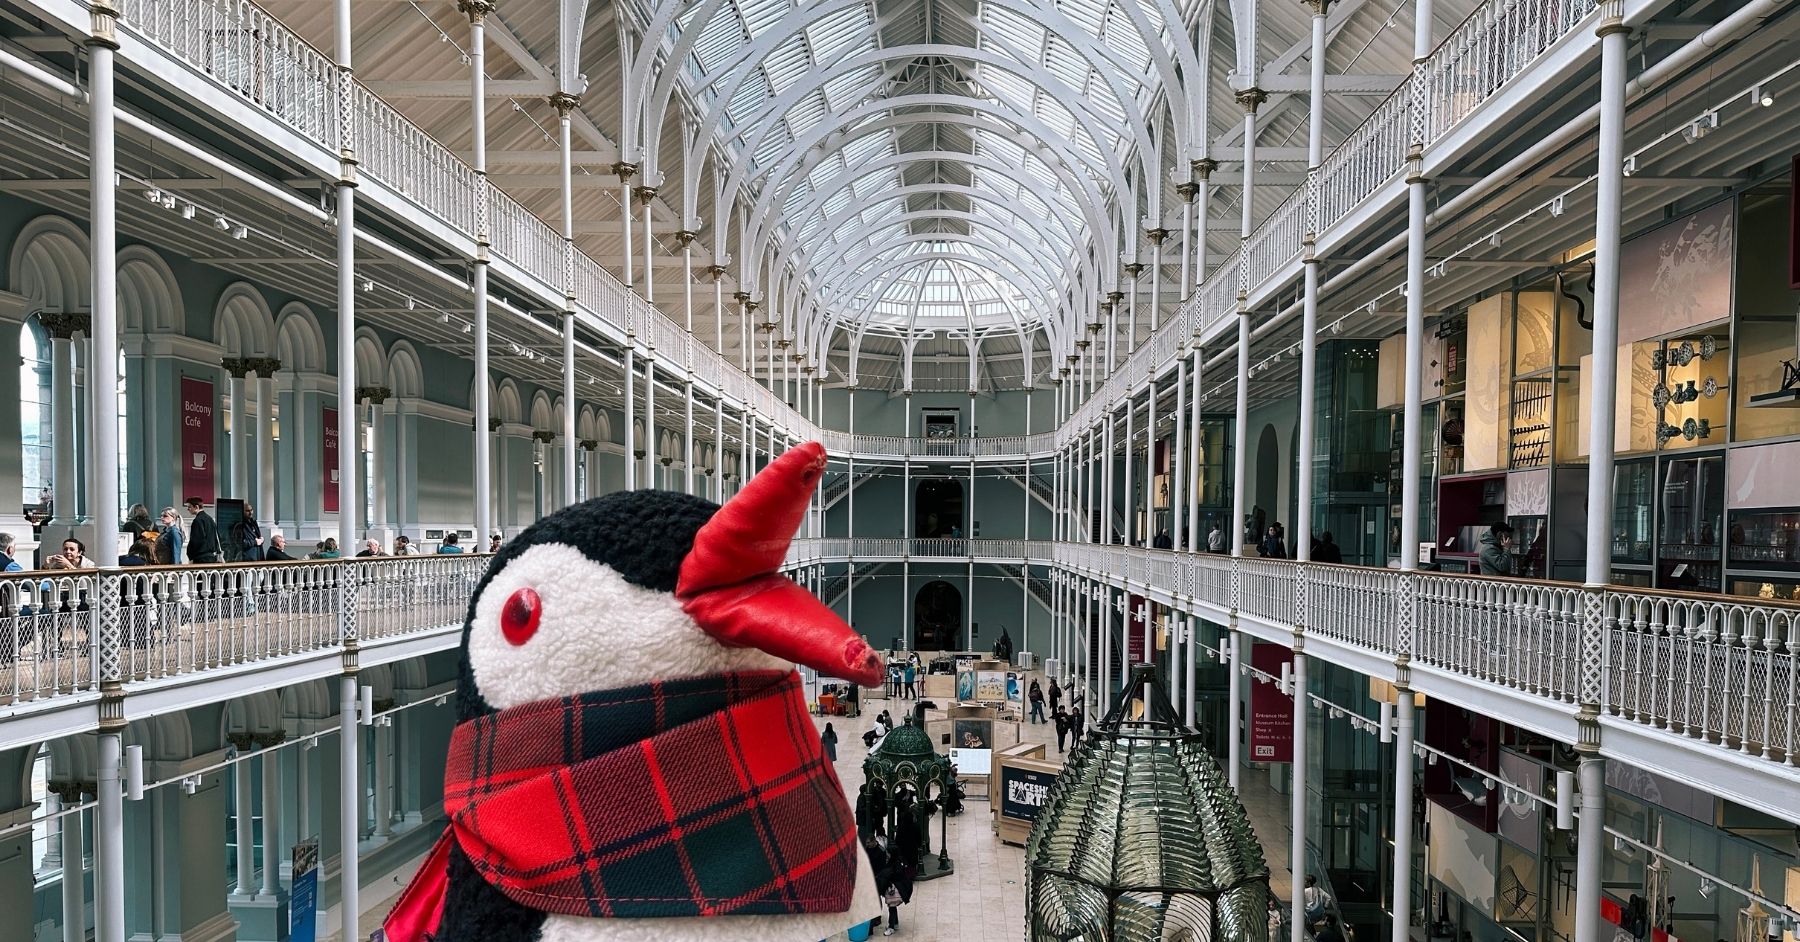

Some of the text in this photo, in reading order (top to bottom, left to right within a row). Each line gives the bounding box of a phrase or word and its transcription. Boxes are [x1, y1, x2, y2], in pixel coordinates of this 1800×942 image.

[185, 401, 212, 416] Balcony
[185, 416, 201, 428] Café
[325, 427, 338, 437] Balco
[1008, 780, 1049, 795] SPACESH
